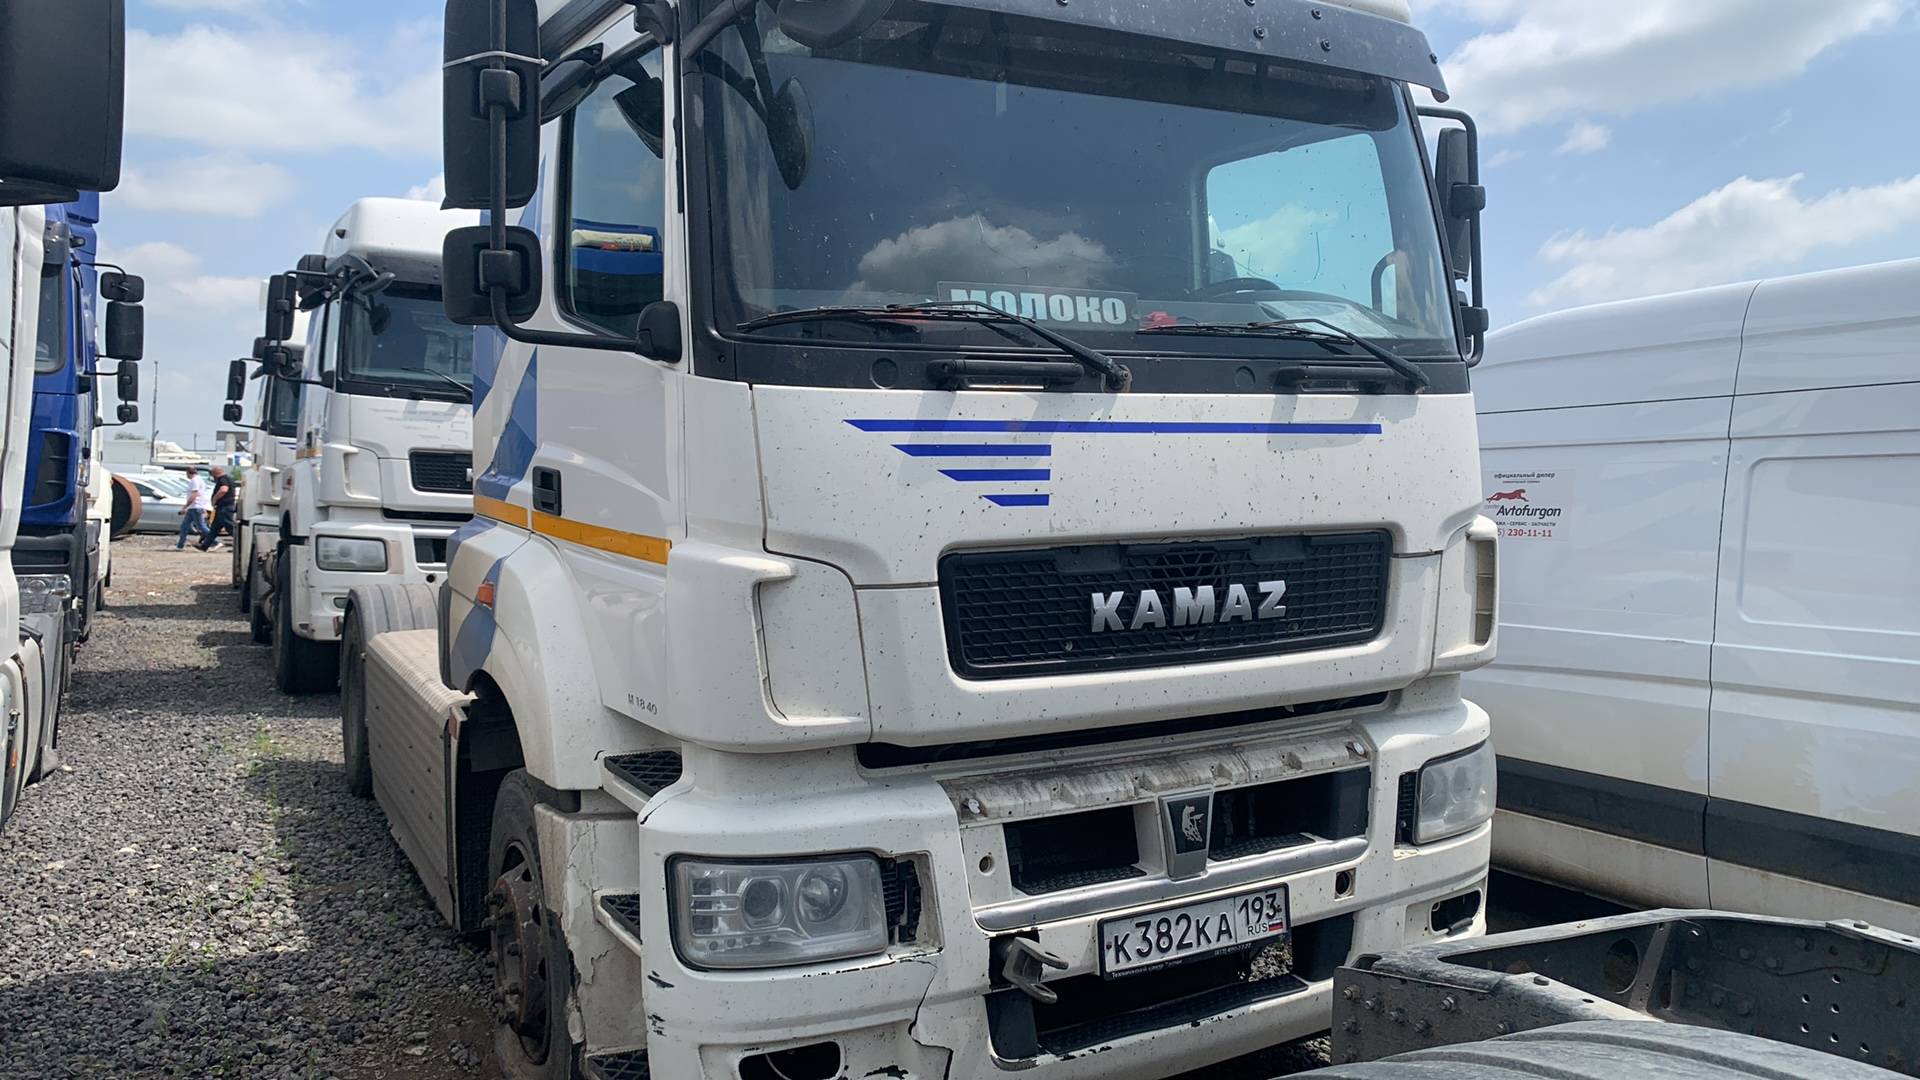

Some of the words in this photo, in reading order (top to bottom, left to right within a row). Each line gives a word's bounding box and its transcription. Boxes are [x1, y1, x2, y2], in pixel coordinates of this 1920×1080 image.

[950, 289, 1127, 325] МОЛОКО
[1496, 505, 1562, 519] Avtofurgon
[1507, 528, 1552, 537] 230-11-11
[1091, 580, 1287, 632] KAMAZ
[1237, 893, 1279, 926] 193
[1247, 924, 1268, 936] RUS
